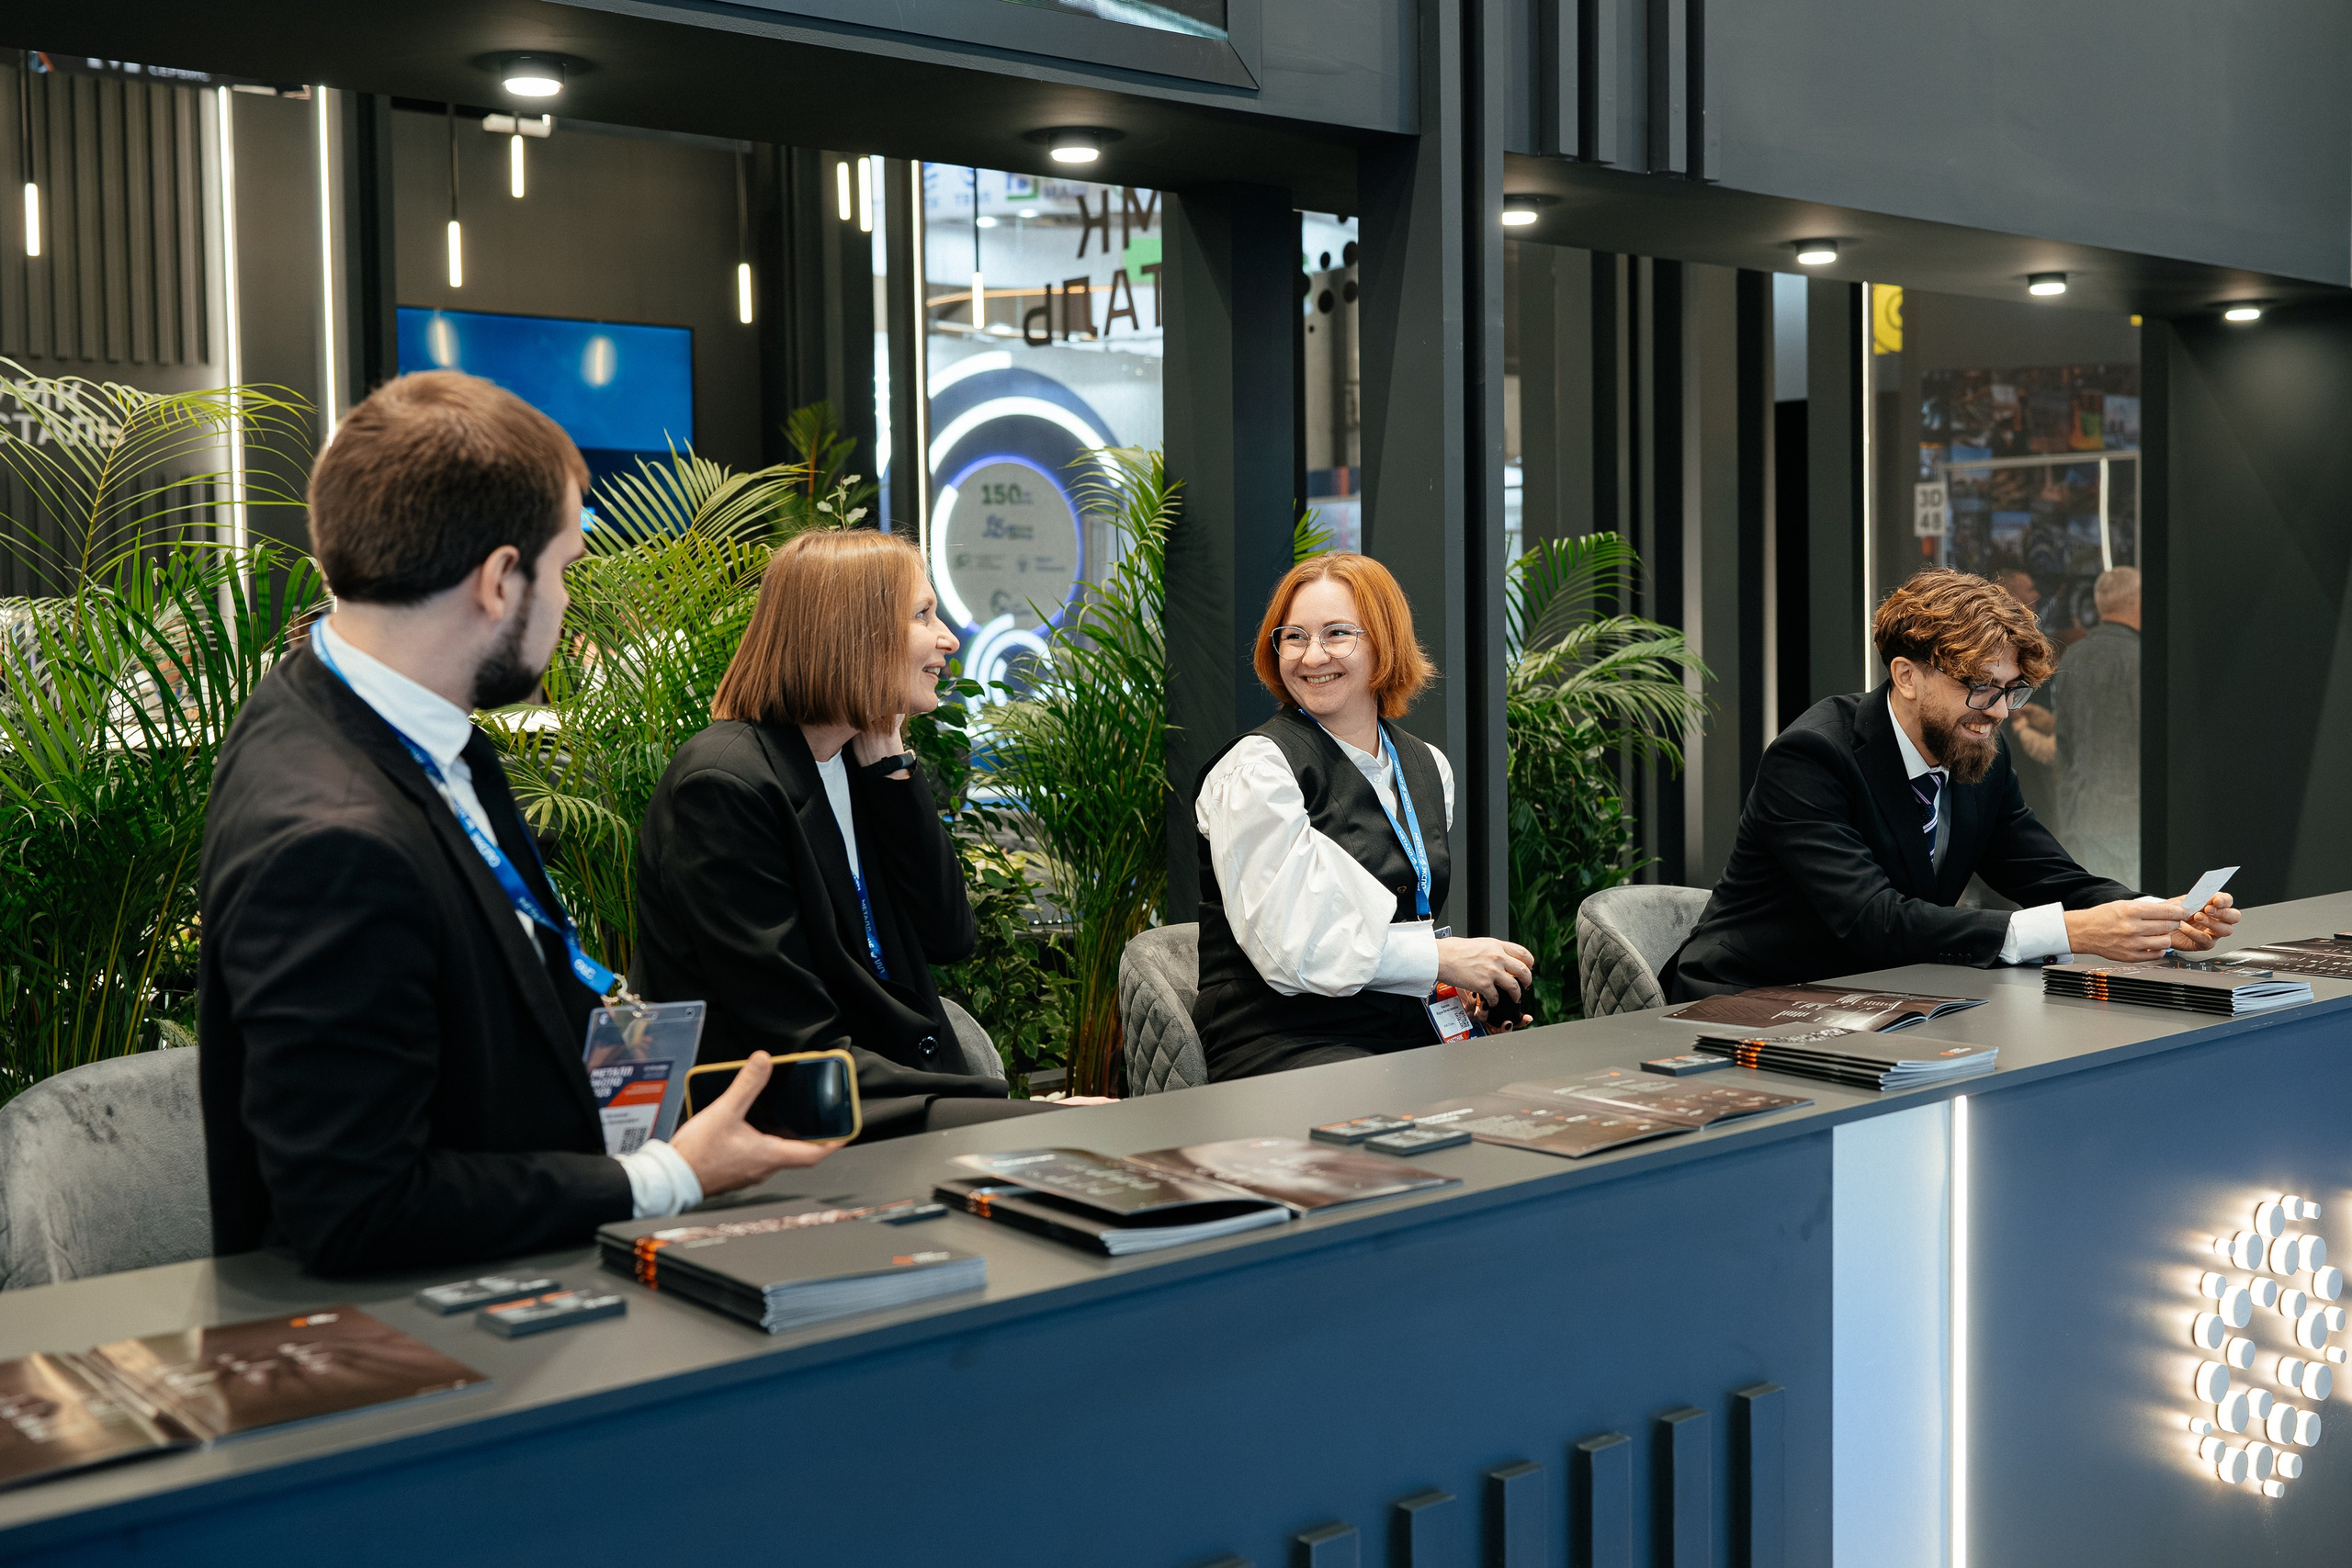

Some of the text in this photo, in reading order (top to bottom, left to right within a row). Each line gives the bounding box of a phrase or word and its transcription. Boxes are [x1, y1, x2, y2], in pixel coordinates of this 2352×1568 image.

[982, 483, 1022, 505] 150
[1393, 759, 1412, 813] МЕТАЛЛ ЭКСПО
[1397, 829, 1413, 857] МЕТАЛЛ
[1413, 831, 1423, 858] МЕТАЛЛ
[1419, 864, 1428, 889] ЭКСПО
